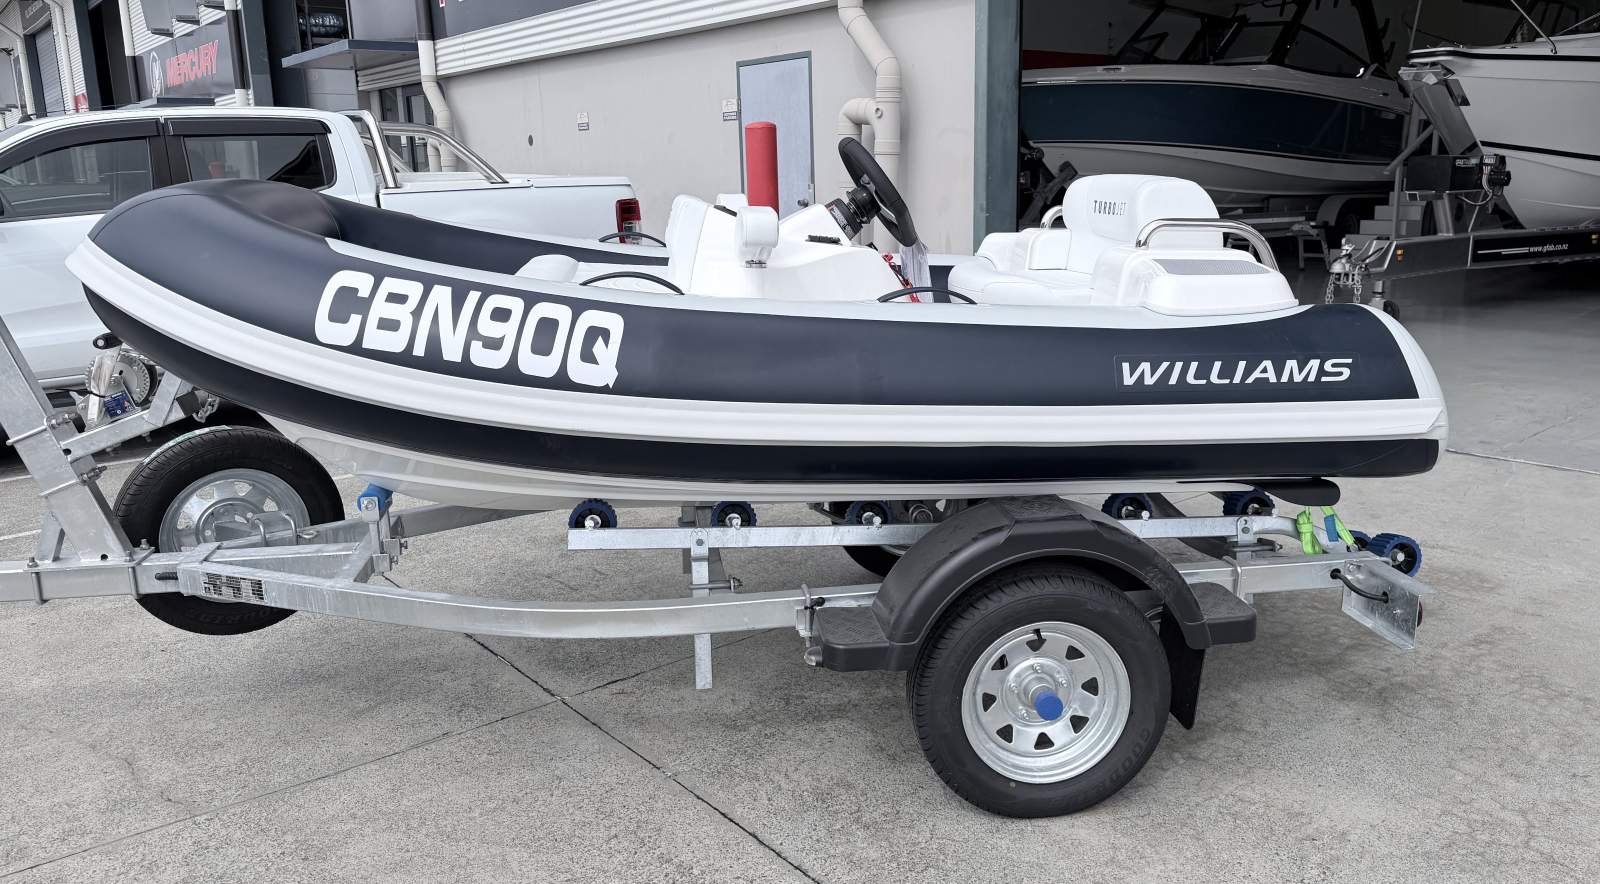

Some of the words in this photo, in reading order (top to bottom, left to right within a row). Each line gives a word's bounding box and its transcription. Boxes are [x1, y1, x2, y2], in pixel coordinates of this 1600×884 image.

[166, 40, 219, 88] MERCURY
[1094, 200, 1127, 215] TURBOJET
[314, 269, 625, 389] CBN90Q
[1121, 358, 1353, 386] WILLIAMS
